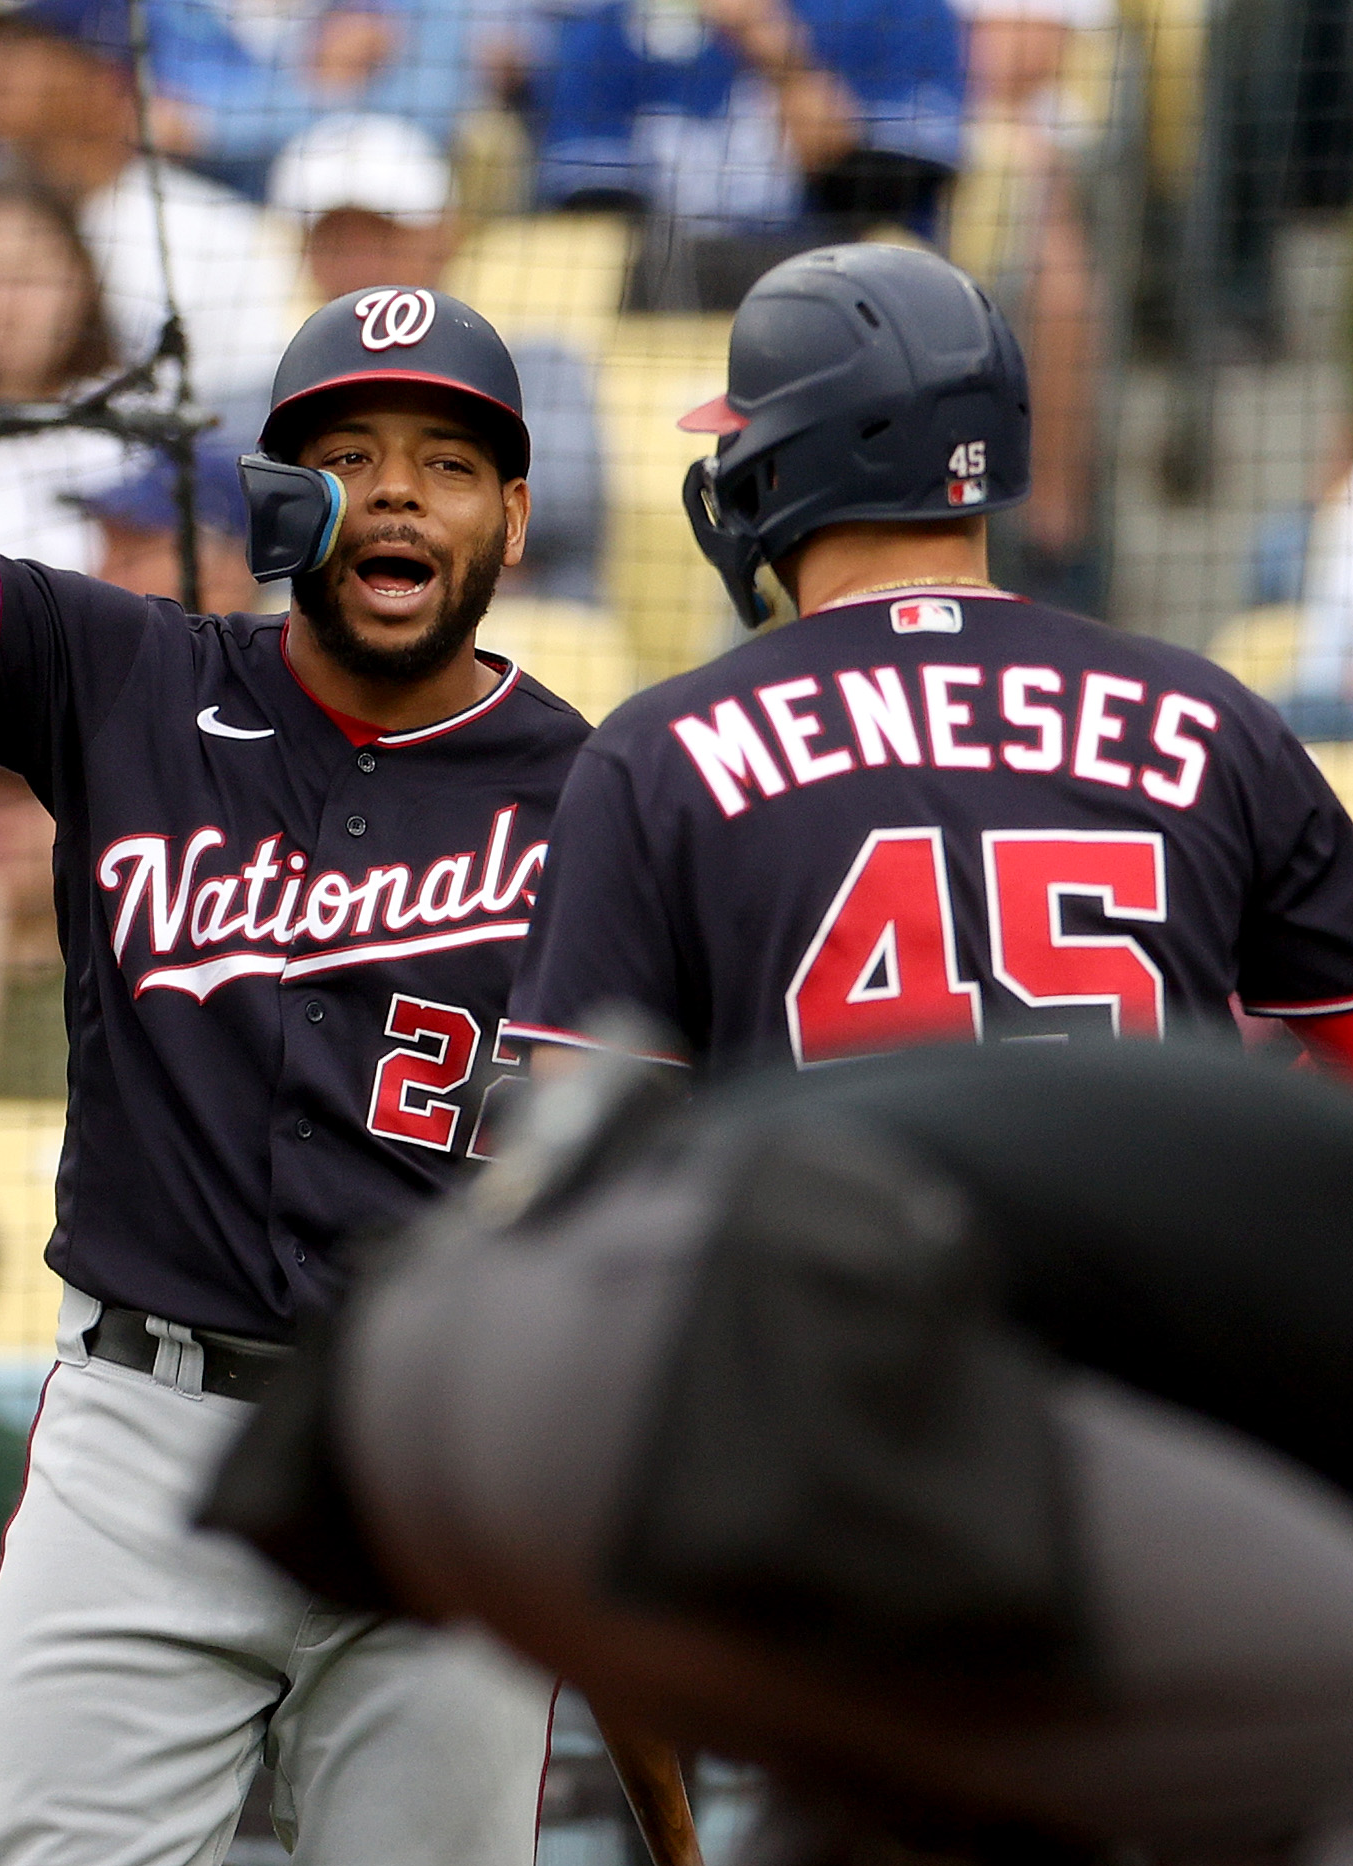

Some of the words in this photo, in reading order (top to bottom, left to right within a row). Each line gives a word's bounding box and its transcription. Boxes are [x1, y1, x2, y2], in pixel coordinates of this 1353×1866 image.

[353, 289, 436, 353] W
[948, 440, 987, 478] 45
[670, 664, 1220, 819] MENESES
[784, 826, 1168, 1071] 45
